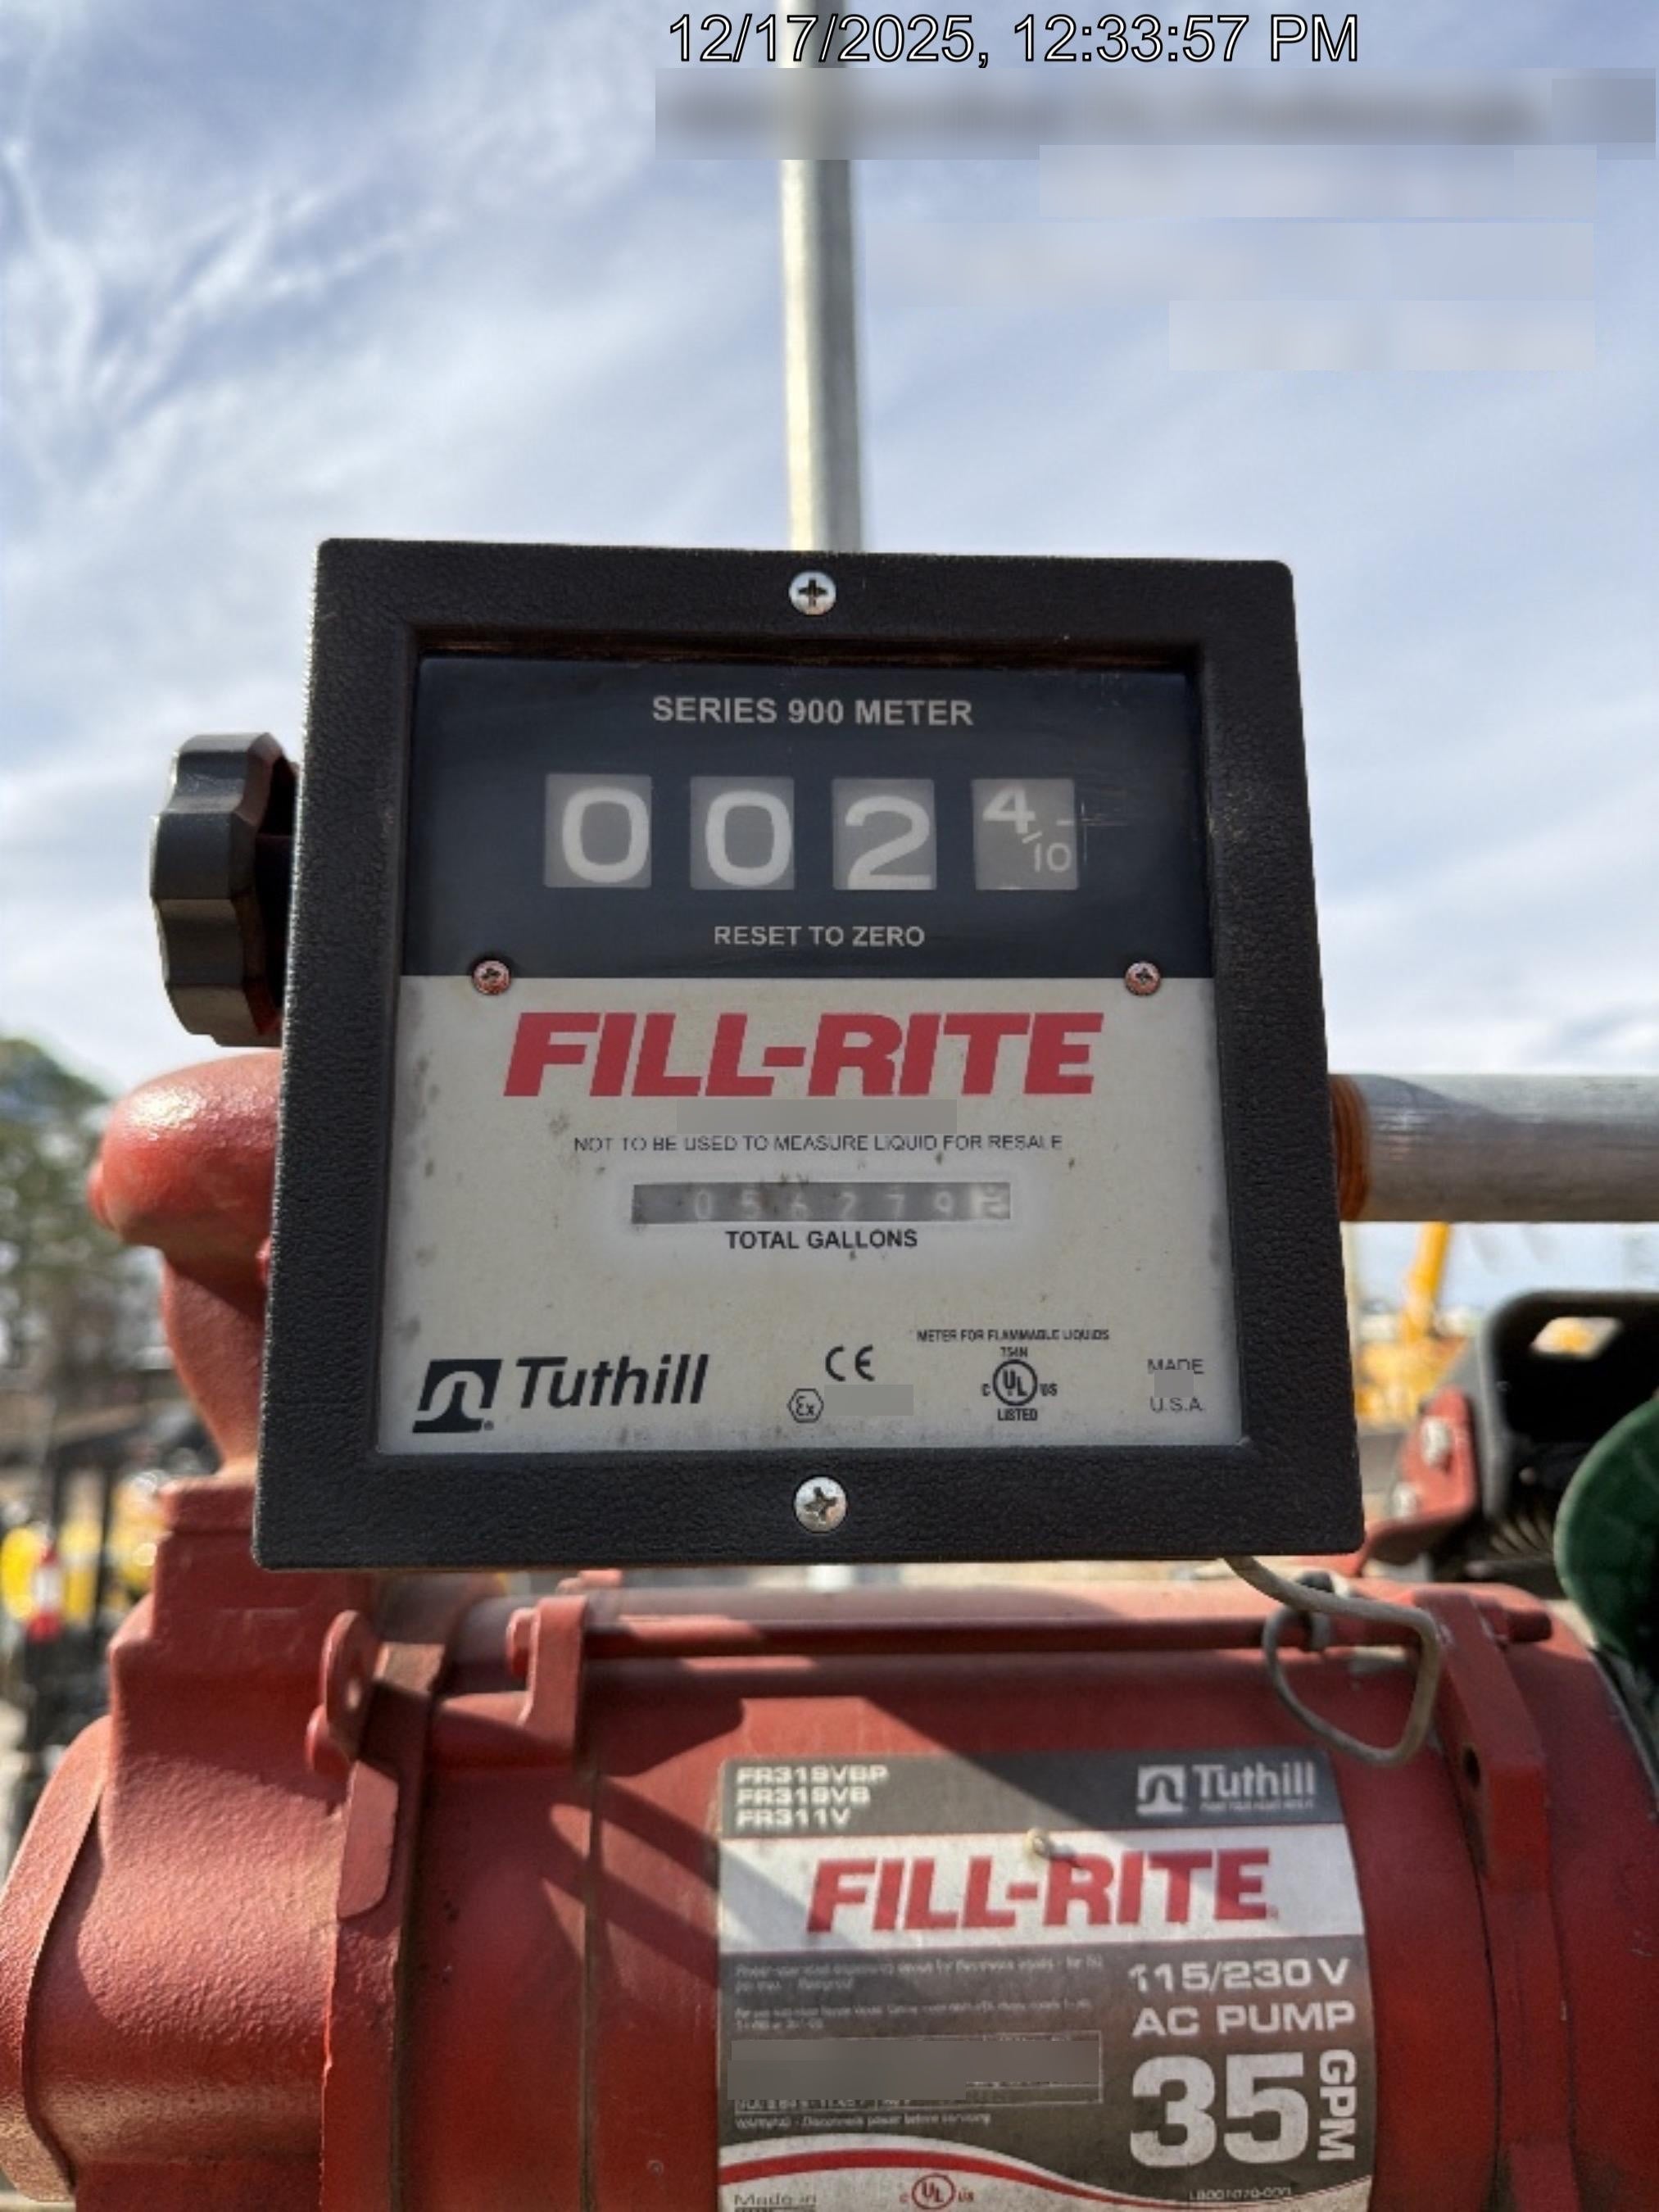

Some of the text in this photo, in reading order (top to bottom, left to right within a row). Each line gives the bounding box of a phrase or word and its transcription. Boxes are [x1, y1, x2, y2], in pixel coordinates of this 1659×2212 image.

[652, 696, 973, 727] SERIES 900 METER
[714, 925, 926, 947] RESET TO ZERO
[503, 1012, 1104, 1096] FILL-RITE
[574, 1135, 1063, 1153] NOT TO BE USED TO MEASURE LIQUID FOR RESALE
[725, 1229, 918, 1249] TOTAL GALLONS
[917, 1330, 957, 1342] METER
[961, 1330, 984, 1341] FOR
[515, 1353, 710, 1409] Tuthill
[825, 1344, 875, 1382] CE
[997, 1408, 1038, 1422] LISTED
[1192, 1761, 1315, 1798] Tuthill
[807, 1848, 1270, 1933] FILL-RITE
[1128, 1957, 1312, 1994] 115/230
[1132, 2000, 1356, 2037] AC PUMP
[1130, 2051, 1309, 2168] 35
[1317, 2049, 1357, 2161] GPM
